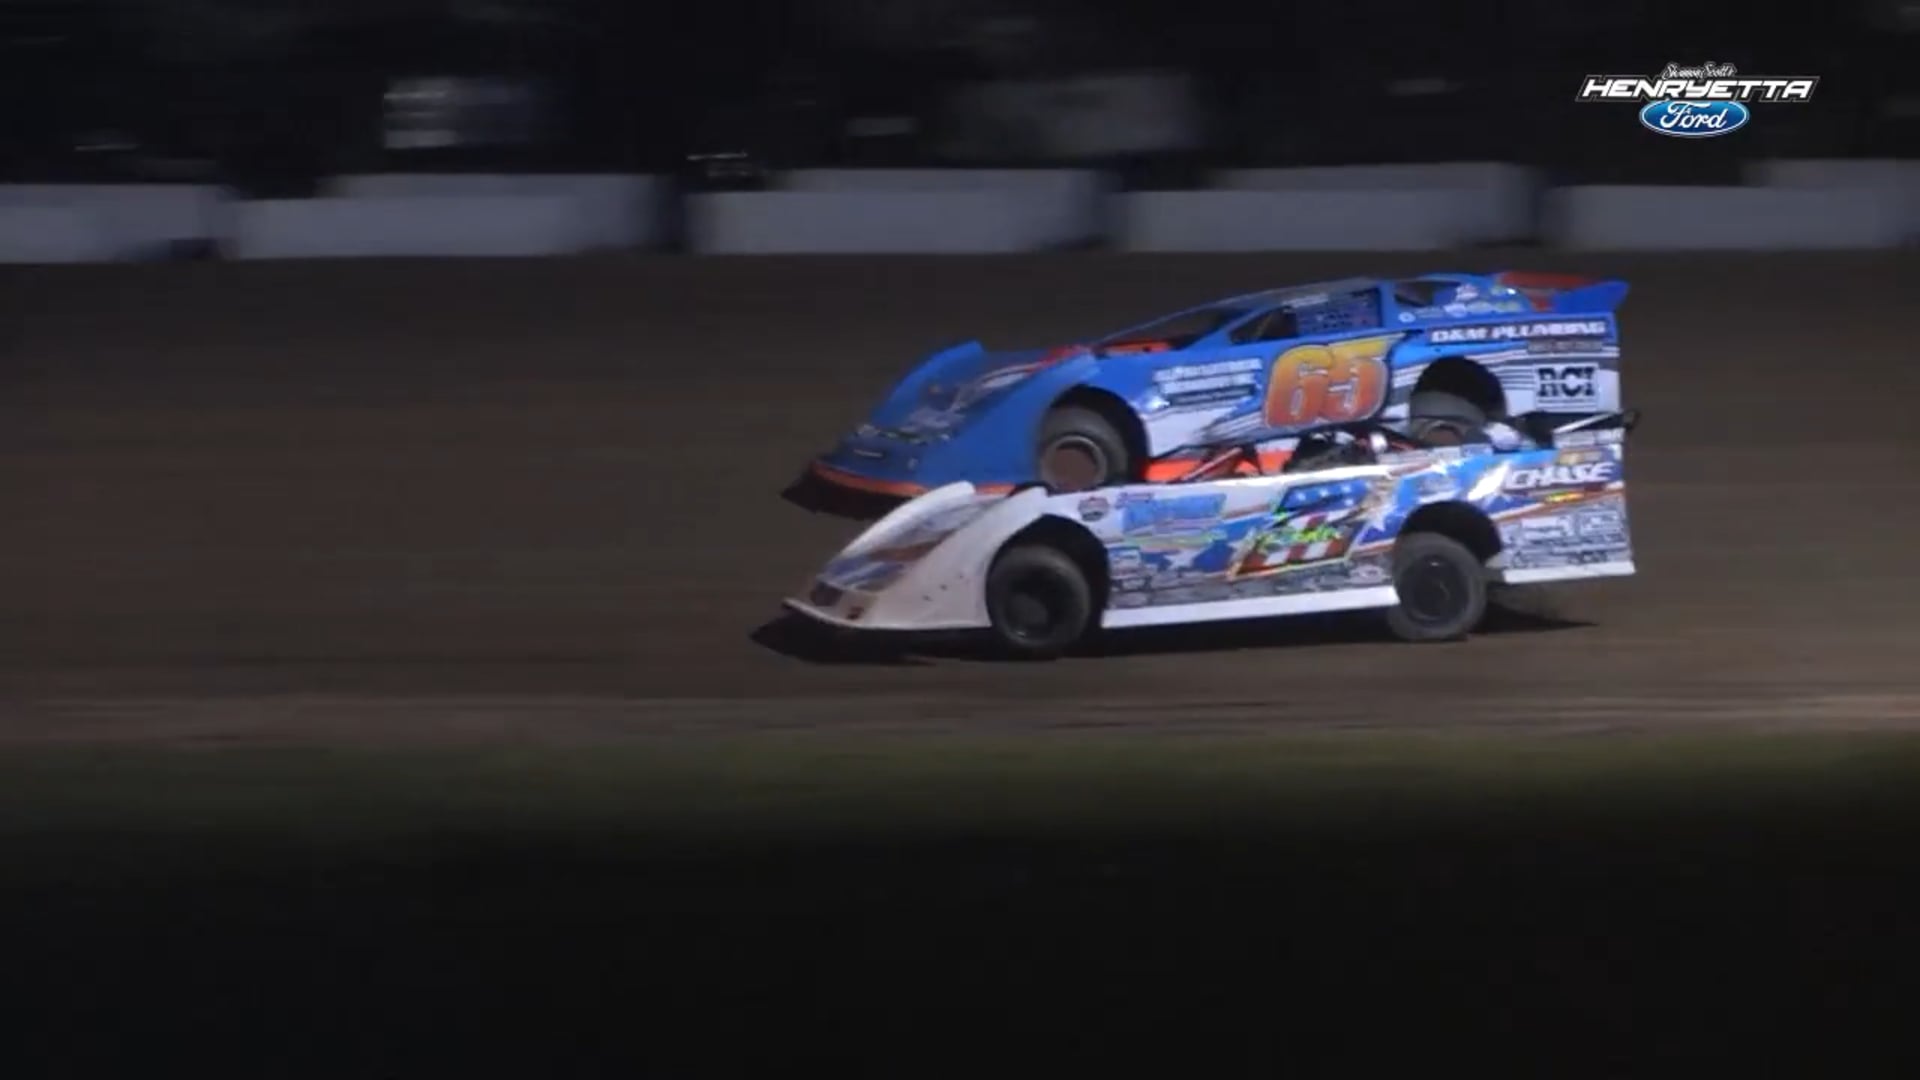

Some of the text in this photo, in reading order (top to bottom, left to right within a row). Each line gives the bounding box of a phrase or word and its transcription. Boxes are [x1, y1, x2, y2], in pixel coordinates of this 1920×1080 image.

[1431, 321, 1606, 342] D&M PLUMBING
[1265, 340, 1400, 429] 65
[1505, 462, 1614, 489] CHASE
